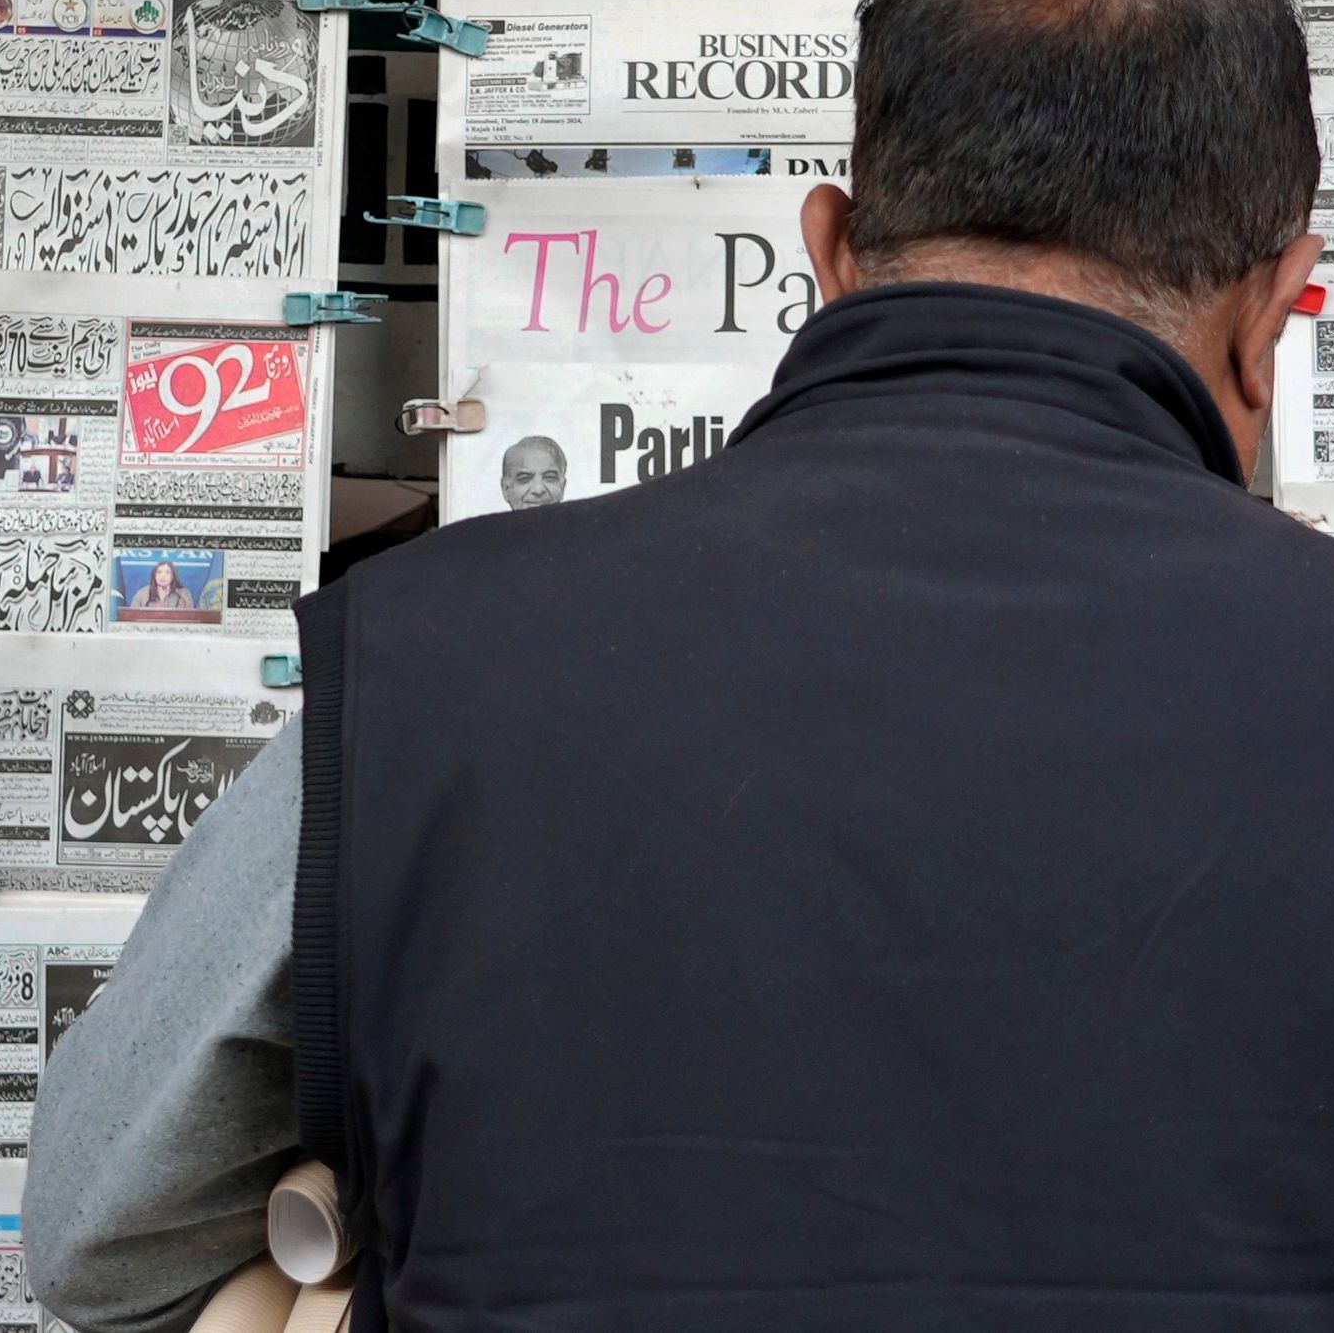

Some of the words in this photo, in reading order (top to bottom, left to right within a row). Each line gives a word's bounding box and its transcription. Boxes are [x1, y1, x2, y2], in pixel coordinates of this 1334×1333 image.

[507, 22, 535, 32] Diesel
[538, 22, 588, 31] Generators
[699, 33, 848, 59] BUSINESS
[622, 61, 858, 100] RECORD
[503, 228, 673, 336] The
[713, 232, 816, 335] Pa
[159, 344, 271, 453] 92
